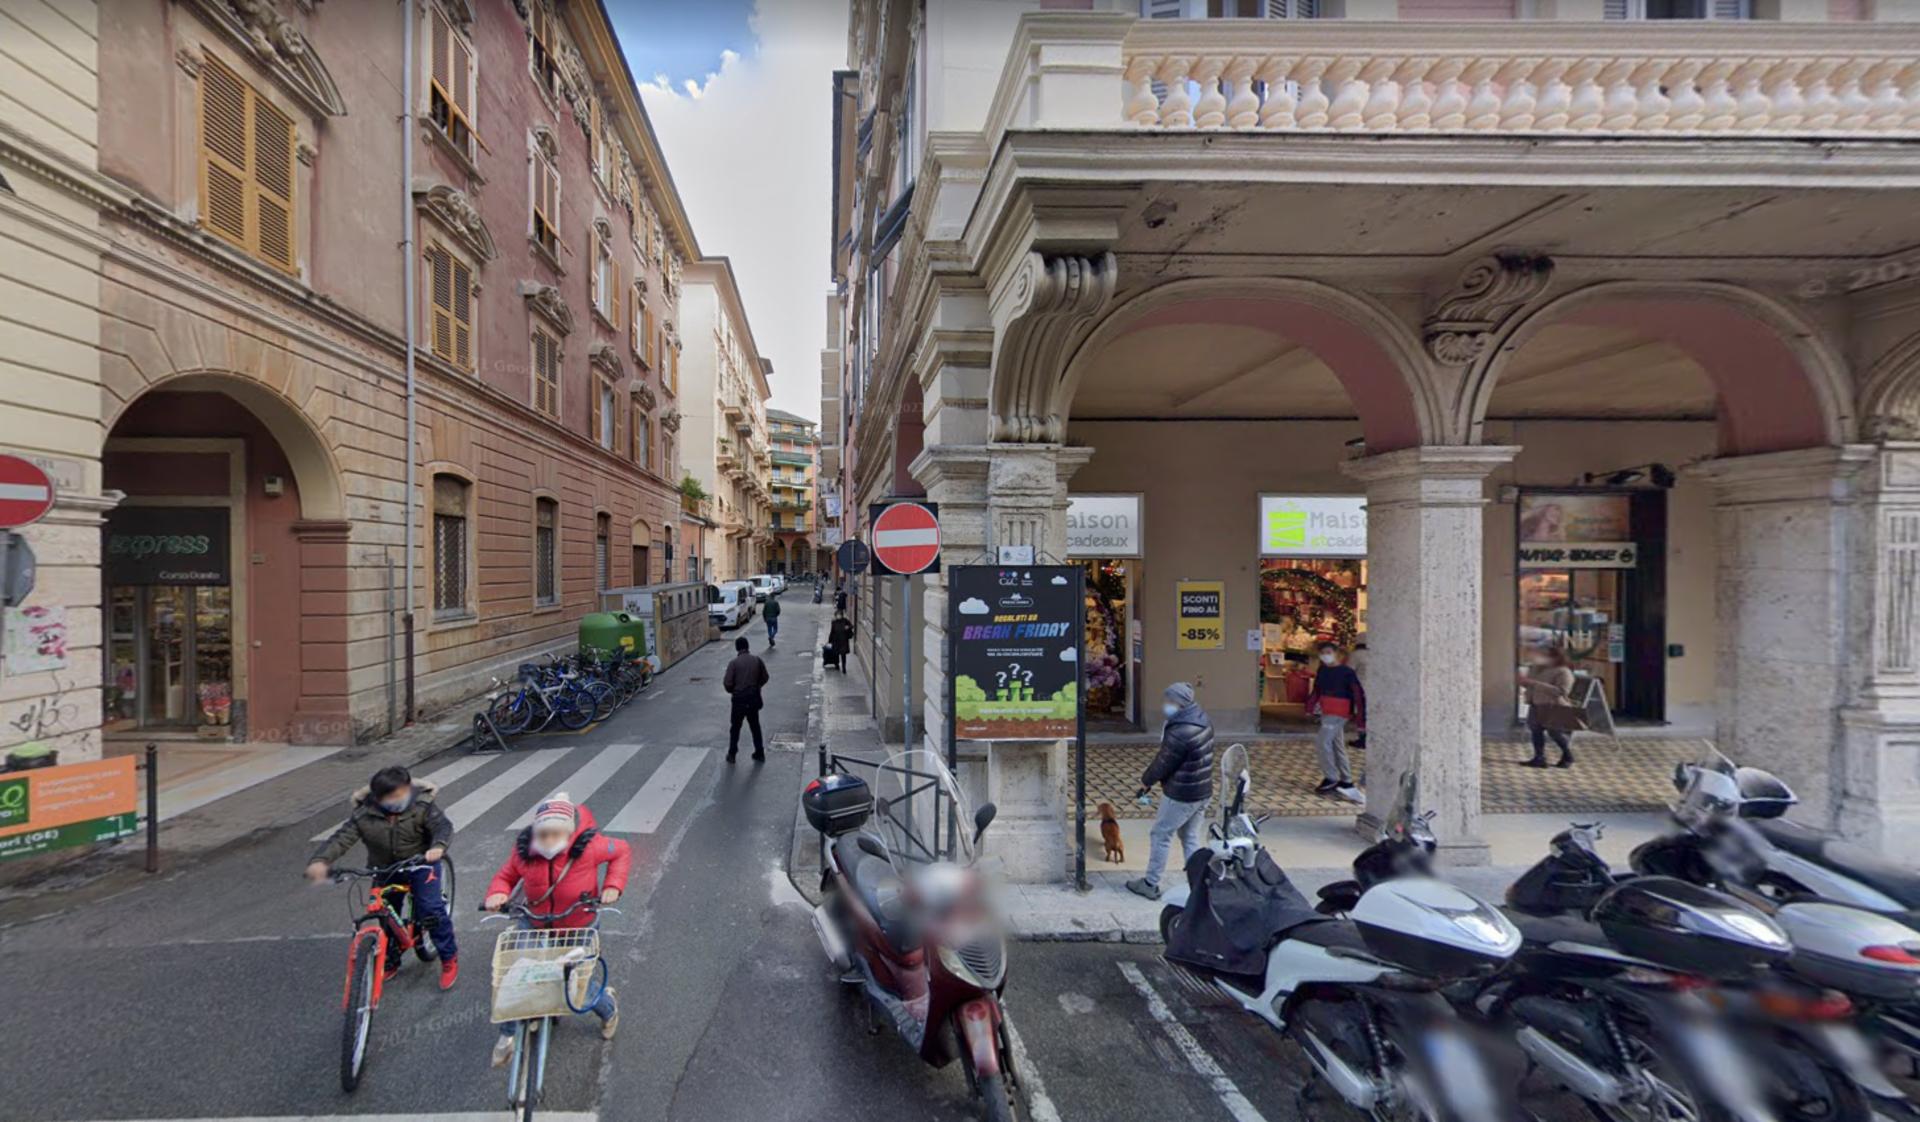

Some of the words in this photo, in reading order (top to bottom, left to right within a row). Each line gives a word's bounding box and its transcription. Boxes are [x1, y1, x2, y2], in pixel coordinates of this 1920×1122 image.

[1066, 512, 1129, 529] aison
[1310, 511, 1365, 529] Mais
[1066, 534, 1129, 548] cadeaux
[1183, 595, 1218, 604] SCONTI
[1182, 606, 1205, 614] FINO
[1206, 606, 1218, 614] AL
[962, 625, 1011, 640] BREAK
[1014, 622, 1071, 640] FRIDAY
[1181, 627, 1221, 641] -85%
